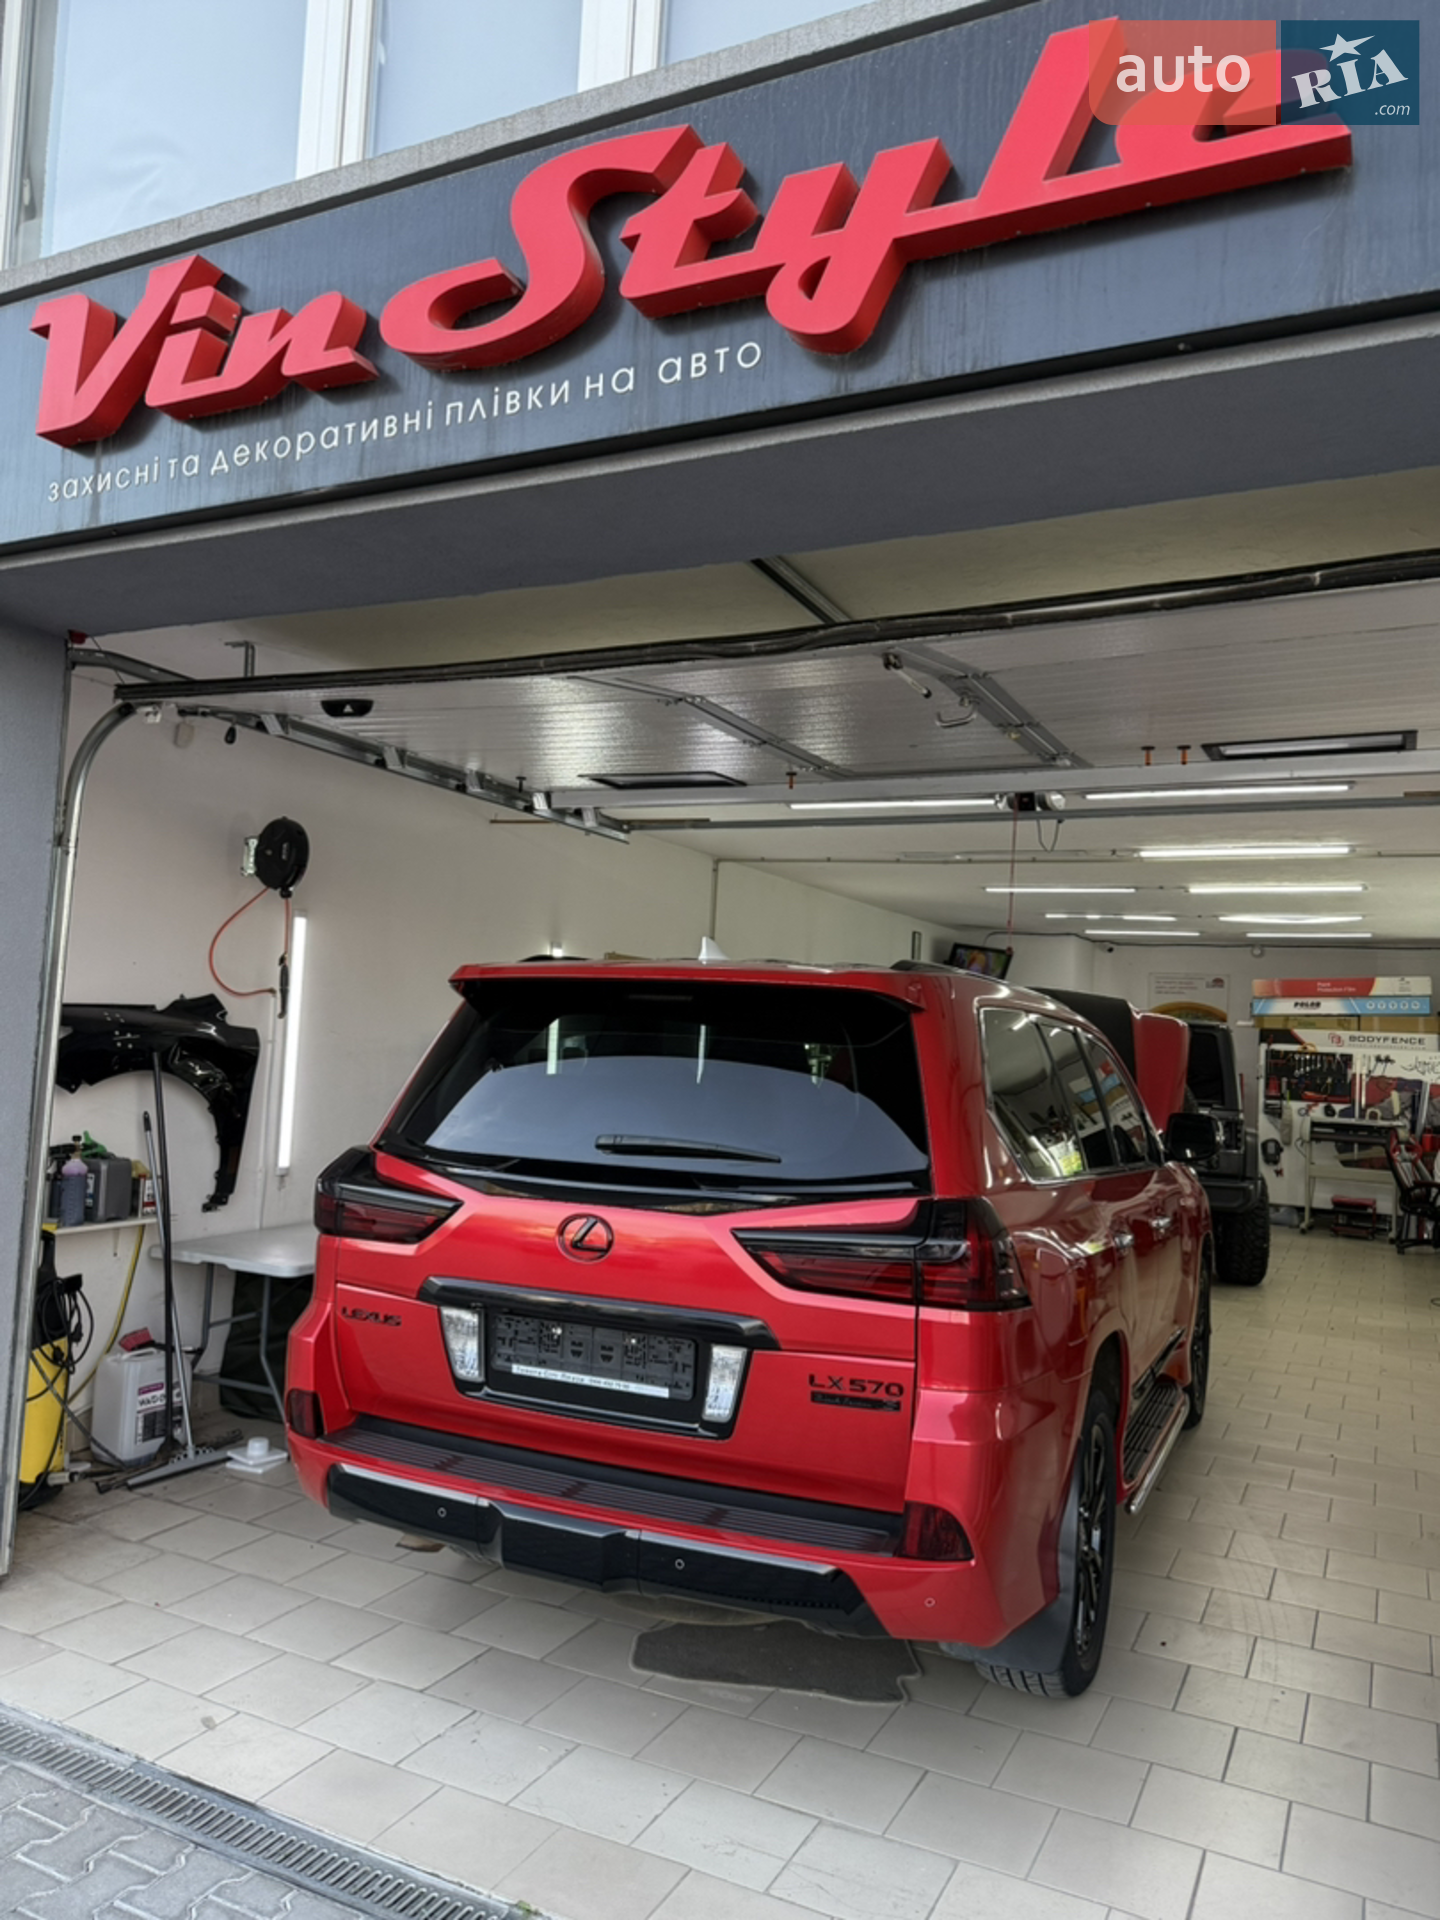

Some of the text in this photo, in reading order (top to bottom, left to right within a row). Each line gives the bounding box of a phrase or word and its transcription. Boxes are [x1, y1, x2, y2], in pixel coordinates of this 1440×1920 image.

[29, 254, 379, 449] Vin
[48, 342, 762, 502] захисні та декоративні плівки на авто
[1348, 1034, 1427, 1046] BODYFENCE
[809, 1374, 904, 1397] LX 570
